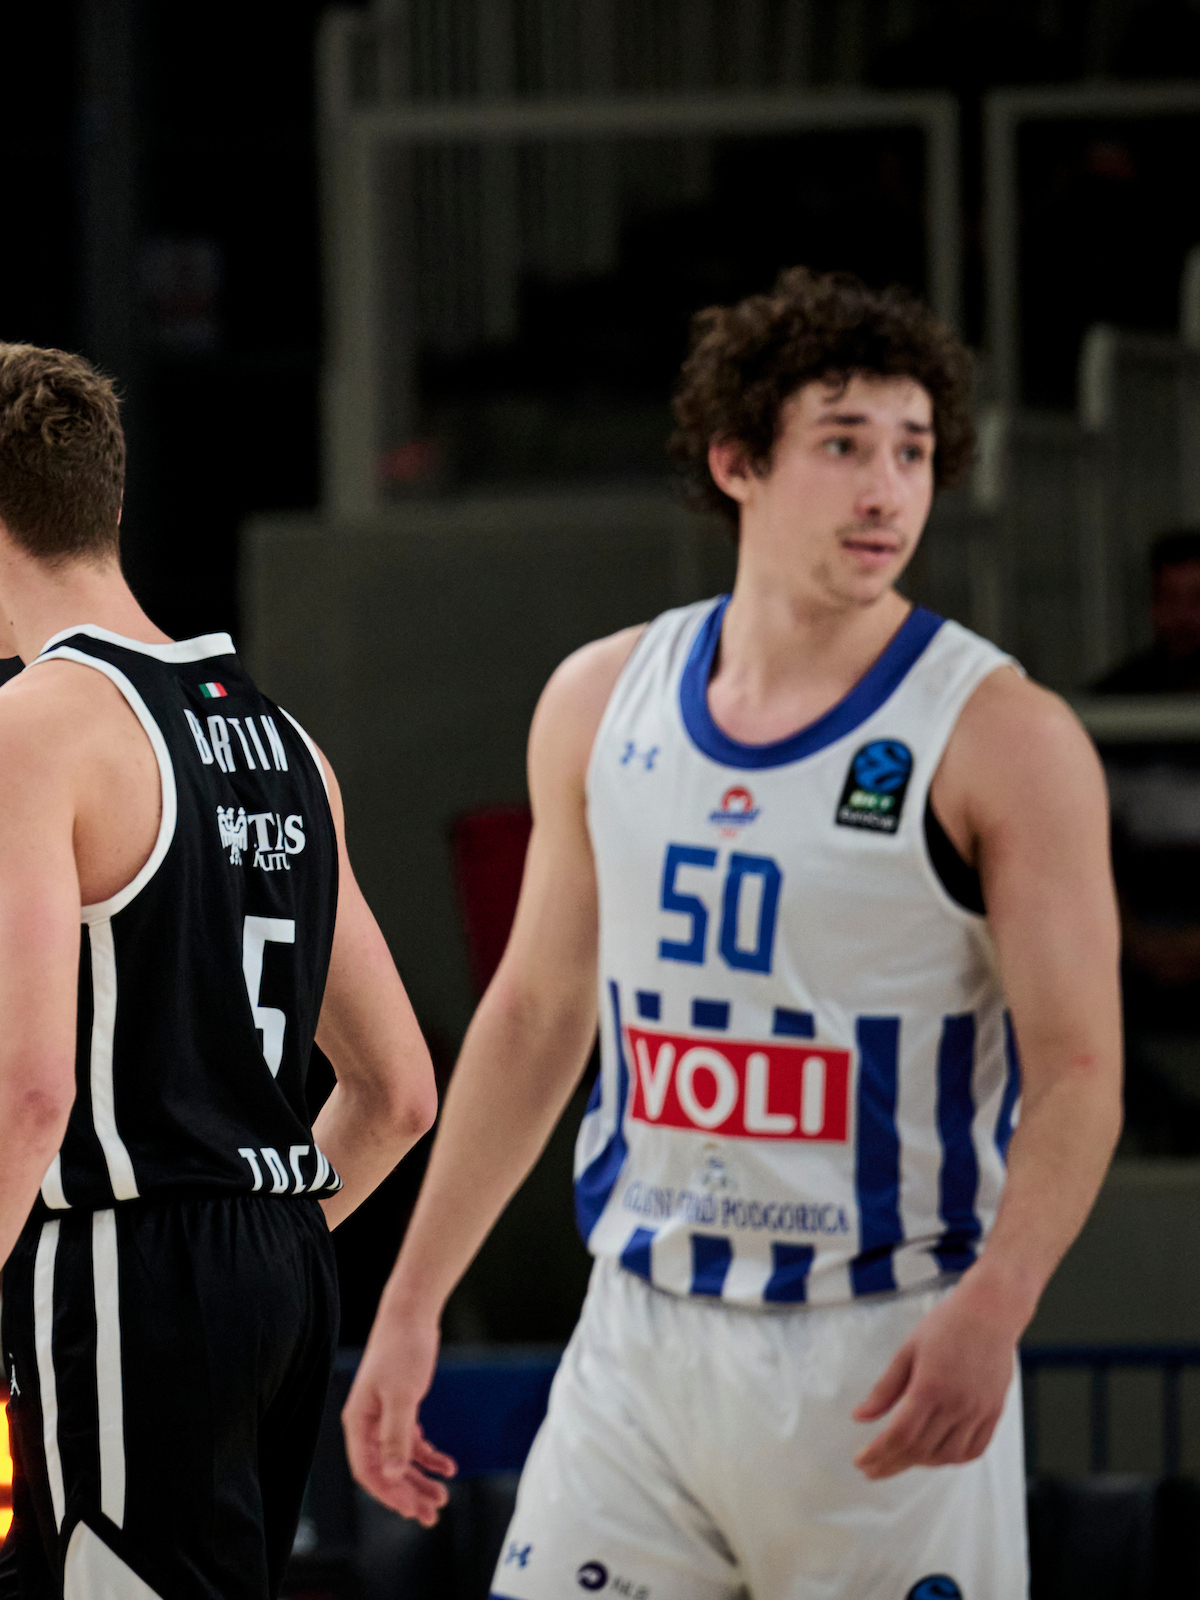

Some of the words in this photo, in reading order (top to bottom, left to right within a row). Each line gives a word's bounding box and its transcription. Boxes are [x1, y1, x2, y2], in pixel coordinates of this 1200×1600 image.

[658, 843, 783, 976] 50
[242, 915, 296, 1079] 5
[634, 1038, 827, 1137] VOLI
